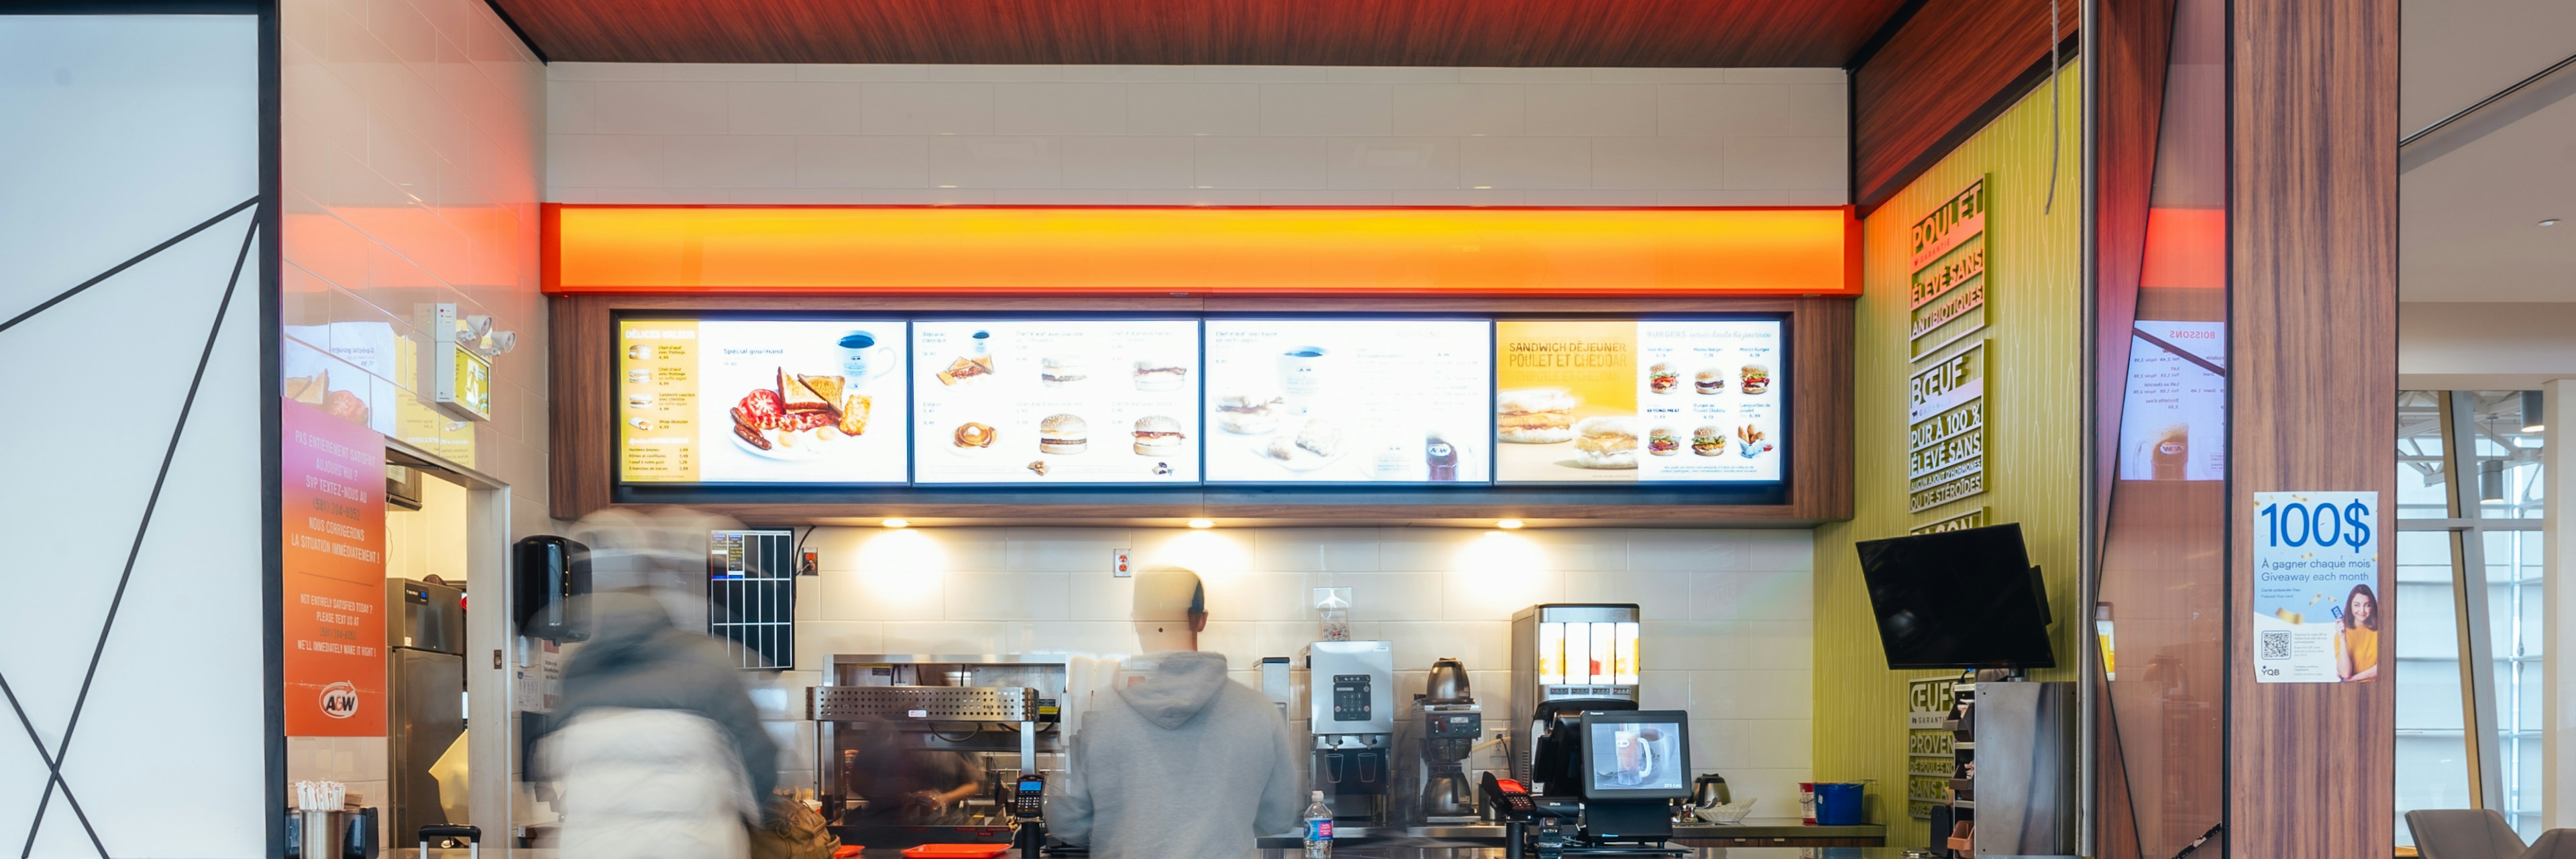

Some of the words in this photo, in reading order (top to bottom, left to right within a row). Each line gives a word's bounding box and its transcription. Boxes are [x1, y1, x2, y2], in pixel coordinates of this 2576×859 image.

[1912, 182, 1982, 252] POULET
[1920, 238, 1951, 263] GARANTIE
[1913, 266, 1950, 305] ÉLEVÉ
[1949, 249, 1983, 283] SANS
[1913, 285, 1983, 337] ANTIBIOTIQUES
[1509, 343, 1567, 352] SANDWICH
[1568, 341, 1627, 352] DÉJEUNER
[1509, 354, 1553, 367] POULET
[1556, 354, 1570, 366] ET
[1574, 354, 1627, 367] CHEDDAR
[1911, 356, 1964, 405] BŒUF
[1911, 423, 1933, 450] PUR
[1936, 416, 1946, 441] À
[1947, 409, 1968, 434] 100
[1972, 404, 1981, 425] %
[295, 430, 307, 445] PAS
[309, 433, 349, 459] ENTIÈREMENT
[350, 448, 377, 468] SATISFAIT
[1911, 442, 1947, 475] ÉLEVÉ
[1948, 433, 1981, 464] SANS
[316, 457, 354, 480] AUJOURD'HUI
[306, 474, 318, 489] SVP
[319, 477, 359, 502] TEXTEZ-NOUS
[360, 491, 368, 503] AU
[1911, 495, 1923, 509] OU
[1924, 491, 1935, 505] DE
[1935, 475, 1981, 503] STÉROÏDES
[309, 516, 325, 532] NOUS
[326, 520, 365, 542] CORRIGERONS
[2261, 499, 2370, 554] 100$
[291, 533, 299, 548] LA
[301, 534, 331, 554] SITUATION
[332, 539, 377, 563] IMMÉDIATEMENT
[2261, 558, 2270, 568] À
[2272, 561, 2308, 571] gagner
[2310, 559, 2346, 570] chaque
[2349, 559, 2371, 568] mois
[2261, 572, 2310, 583] Giveaway
[2313, 572, 2337, 581] each
[2339, 572, 2369, 581] month
[301, 593, 310, 604] NOT
[311, 595, 333, 608] ENTIRELY
[333, 598, 356, 612] SATISFIED
[356, 602, 370, 614] TODAY
[316, 611, 334, 623] PLEASE
[335, 613, 346, 624] TEXT
[346, 615, 354, 625] US
[354, 616, 360, 626] AT
[297, 639, 313, 651] WE'LL
[313, 642, 343, 654] IMMEDIATELY
[343, 644, 356, 656] MAKE
[356, 646, 361, 656] IT
[361, 647, 374, 657] RIGHT
[2261, 668, 2280, 676] YQB
[325, 695, 356, 711] A&W
[1910, 735, 1955, 754] PROVEN
[1910, 780, 1936, 801] SANS
